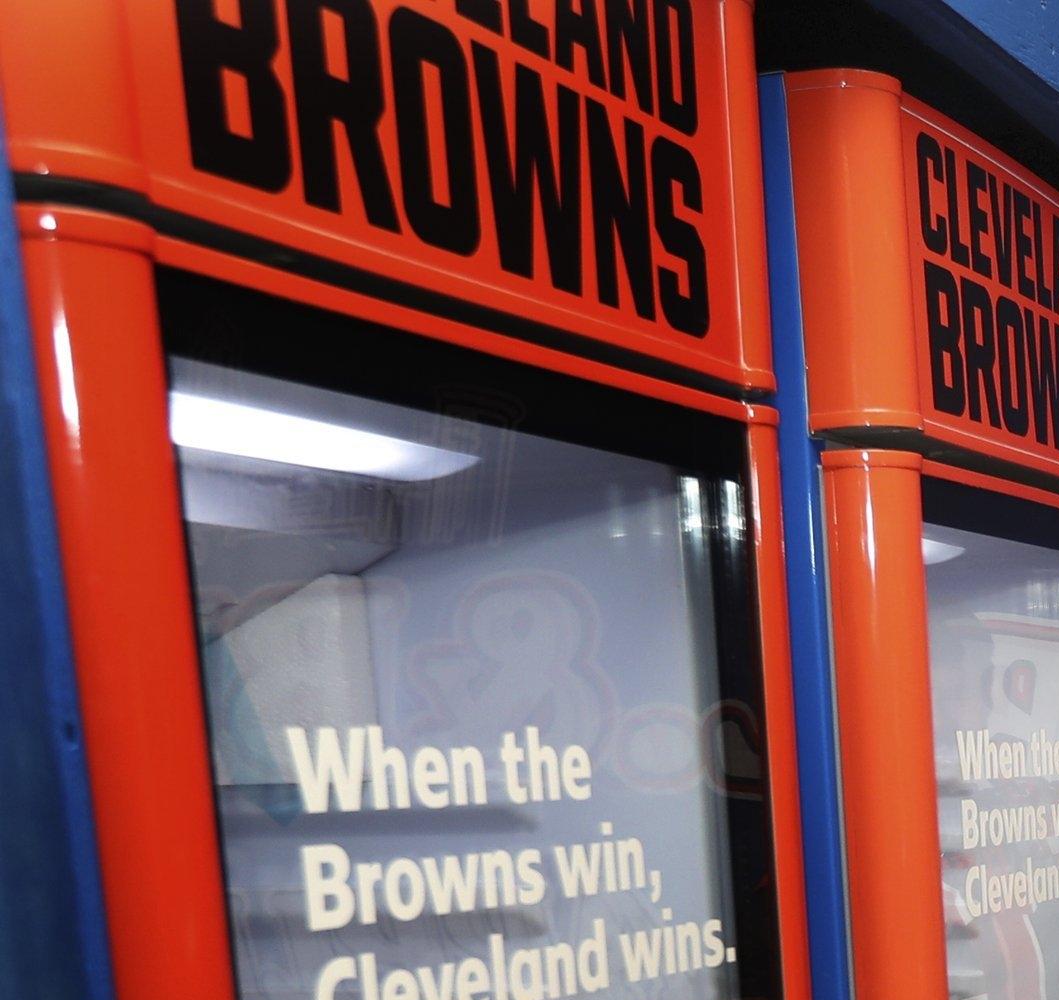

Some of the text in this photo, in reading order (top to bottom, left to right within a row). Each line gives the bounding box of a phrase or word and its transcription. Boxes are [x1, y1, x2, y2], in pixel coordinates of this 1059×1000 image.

[180, 0, 710, 340] BROWNS
[287, 725, 592, 813] When the
[956, 728, 1026, 781] When
[961, 799, 1047, 849] Browns
[302, 822, 662, 931] Browns win,
[620, 908, 737, 982] wins.
